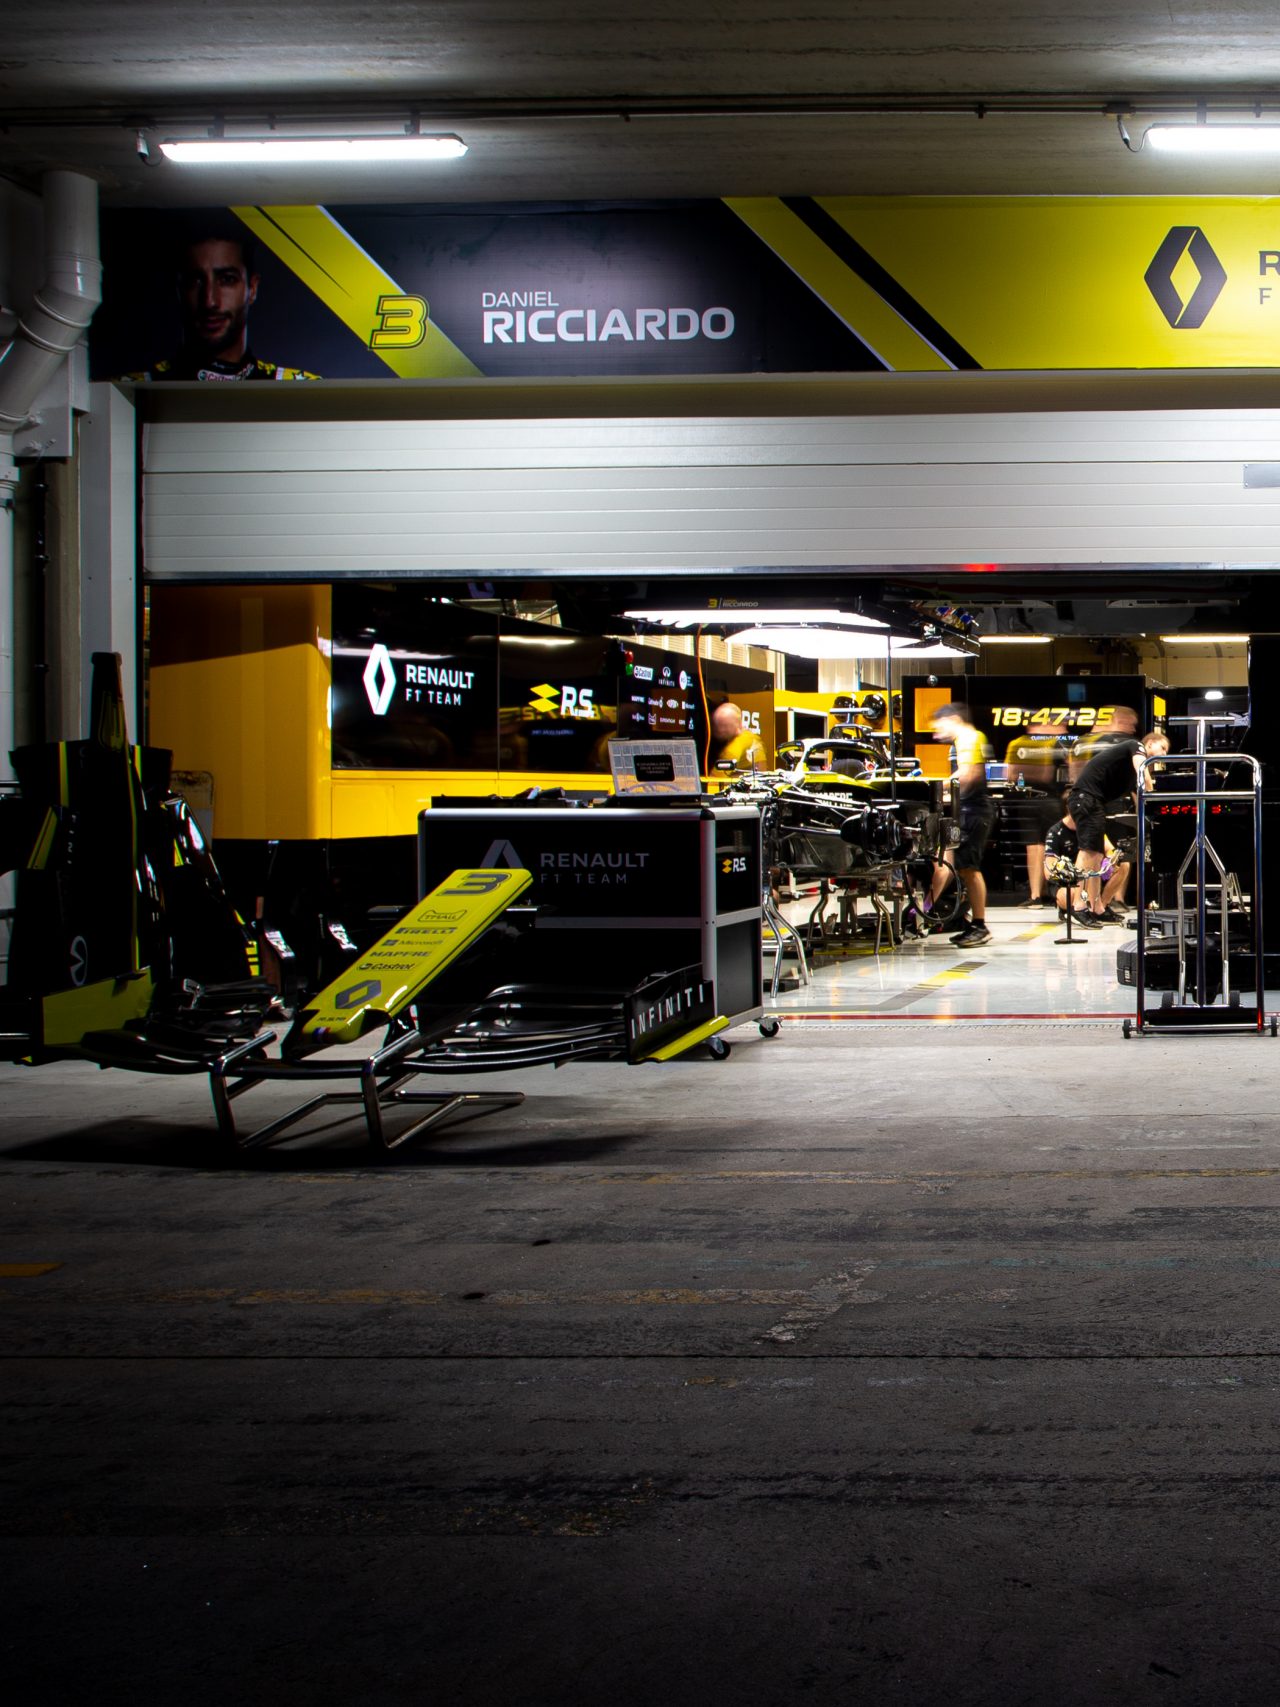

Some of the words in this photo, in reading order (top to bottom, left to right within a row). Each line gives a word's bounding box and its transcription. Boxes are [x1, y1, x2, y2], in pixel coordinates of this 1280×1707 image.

[482, 291, 559, 308] DANIEL
[369, 294, 430, 350] 3
[483, 307, 735, 343] RICCIARDO
[708, 598, 718, 608] 3
[405, 663, 475, 689] RENAULT
[405, 688, 421, 702] F1
[428, 690, 461, 706] TEAM
[991, 707, 1116, 726] 18:47:25
[540, 852, 650, 868] RENAULT
[435, 872, 512, 896] 3
[540, 873, 560, 884] F1
[575, 873, 627, 884] TEAM
[395, 927, 458, 935] PIRELLI
[631, 984, 704, 1040] INFINITI
